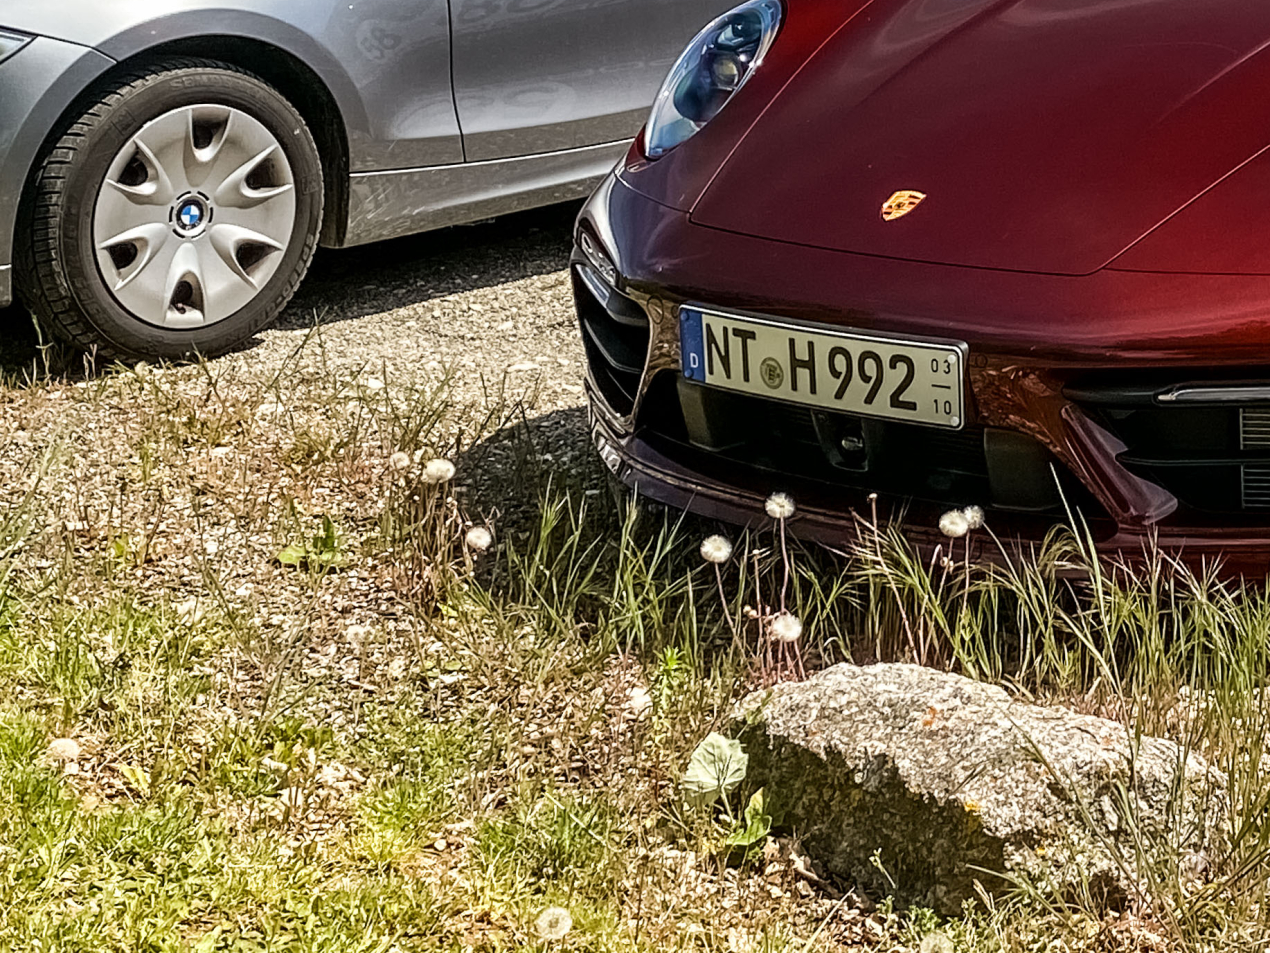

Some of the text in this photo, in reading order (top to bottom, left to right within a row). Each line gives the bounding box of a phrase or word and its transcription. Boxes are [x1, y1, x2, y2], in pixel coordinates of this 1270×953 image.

[690, 353, 698, 367] D
[706, 323, 917, 411] NT H 992
[931, 358, 951, 374] 03
[933, 399, 952, 415] 10
